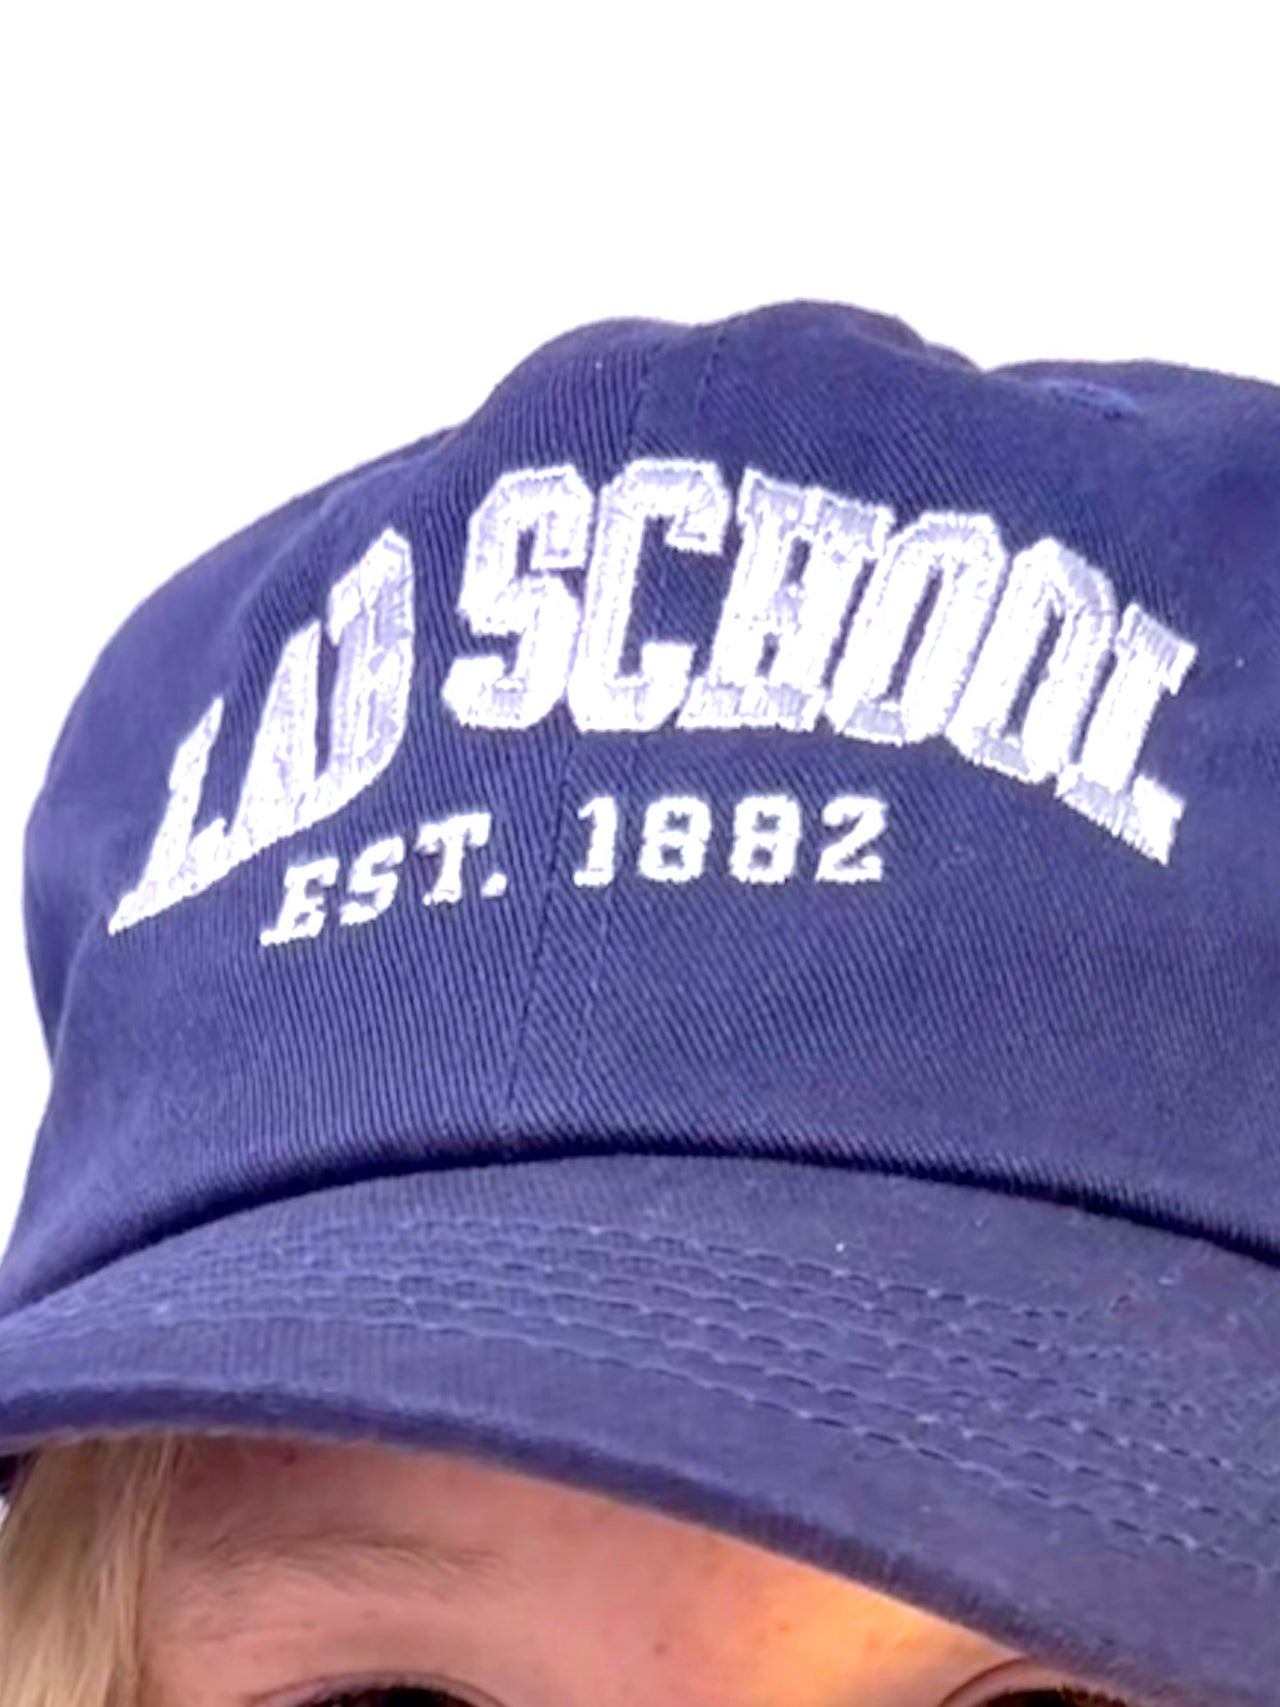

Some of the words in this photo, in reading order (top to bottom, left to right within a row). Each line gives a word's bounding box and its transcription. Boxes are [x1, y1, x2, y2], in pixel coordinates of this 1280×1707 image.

[108, 527, 415, 936] LAB
[440, 458, 1198, 866] SCHOOL
[259, 812, 508, 946] EST.
[572, 795, 887, 887] 1882
